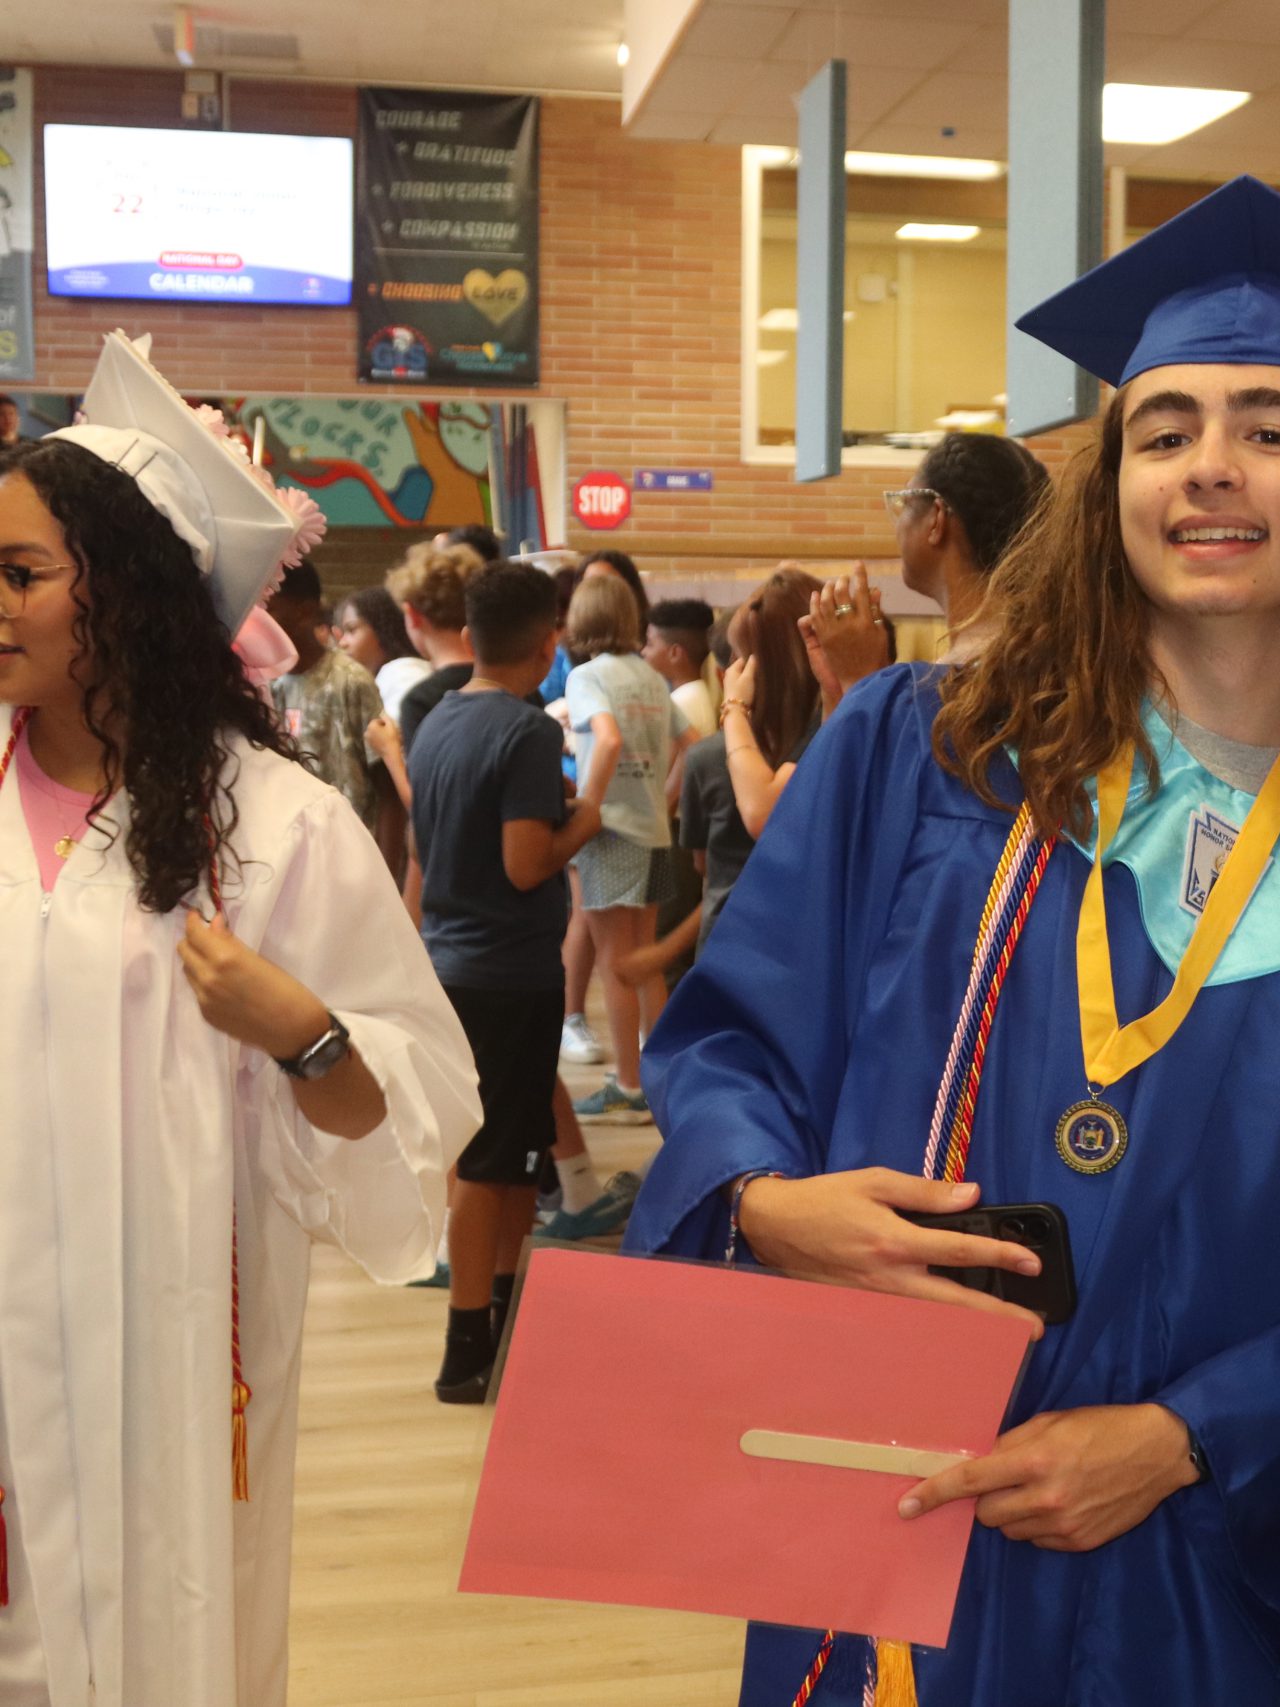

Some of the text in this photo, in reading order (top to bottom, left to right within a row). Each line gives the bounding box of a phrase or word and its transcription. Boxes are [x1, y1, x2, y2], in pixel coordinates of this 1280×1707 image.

[375, 109, 463, 131] COURAGE
[413, 140, 518, 168] GRATITUDE
[389, 180, 516, 201] FORGIVENESS
[111, 193, 144, 214] 22
[399, 217, 520, 241] COMPASSION
[149, 272, 255, 294] CALENDAR
[382, 280, 463, 302] CHOOSING
[579, 485, 626, 515] STOP
